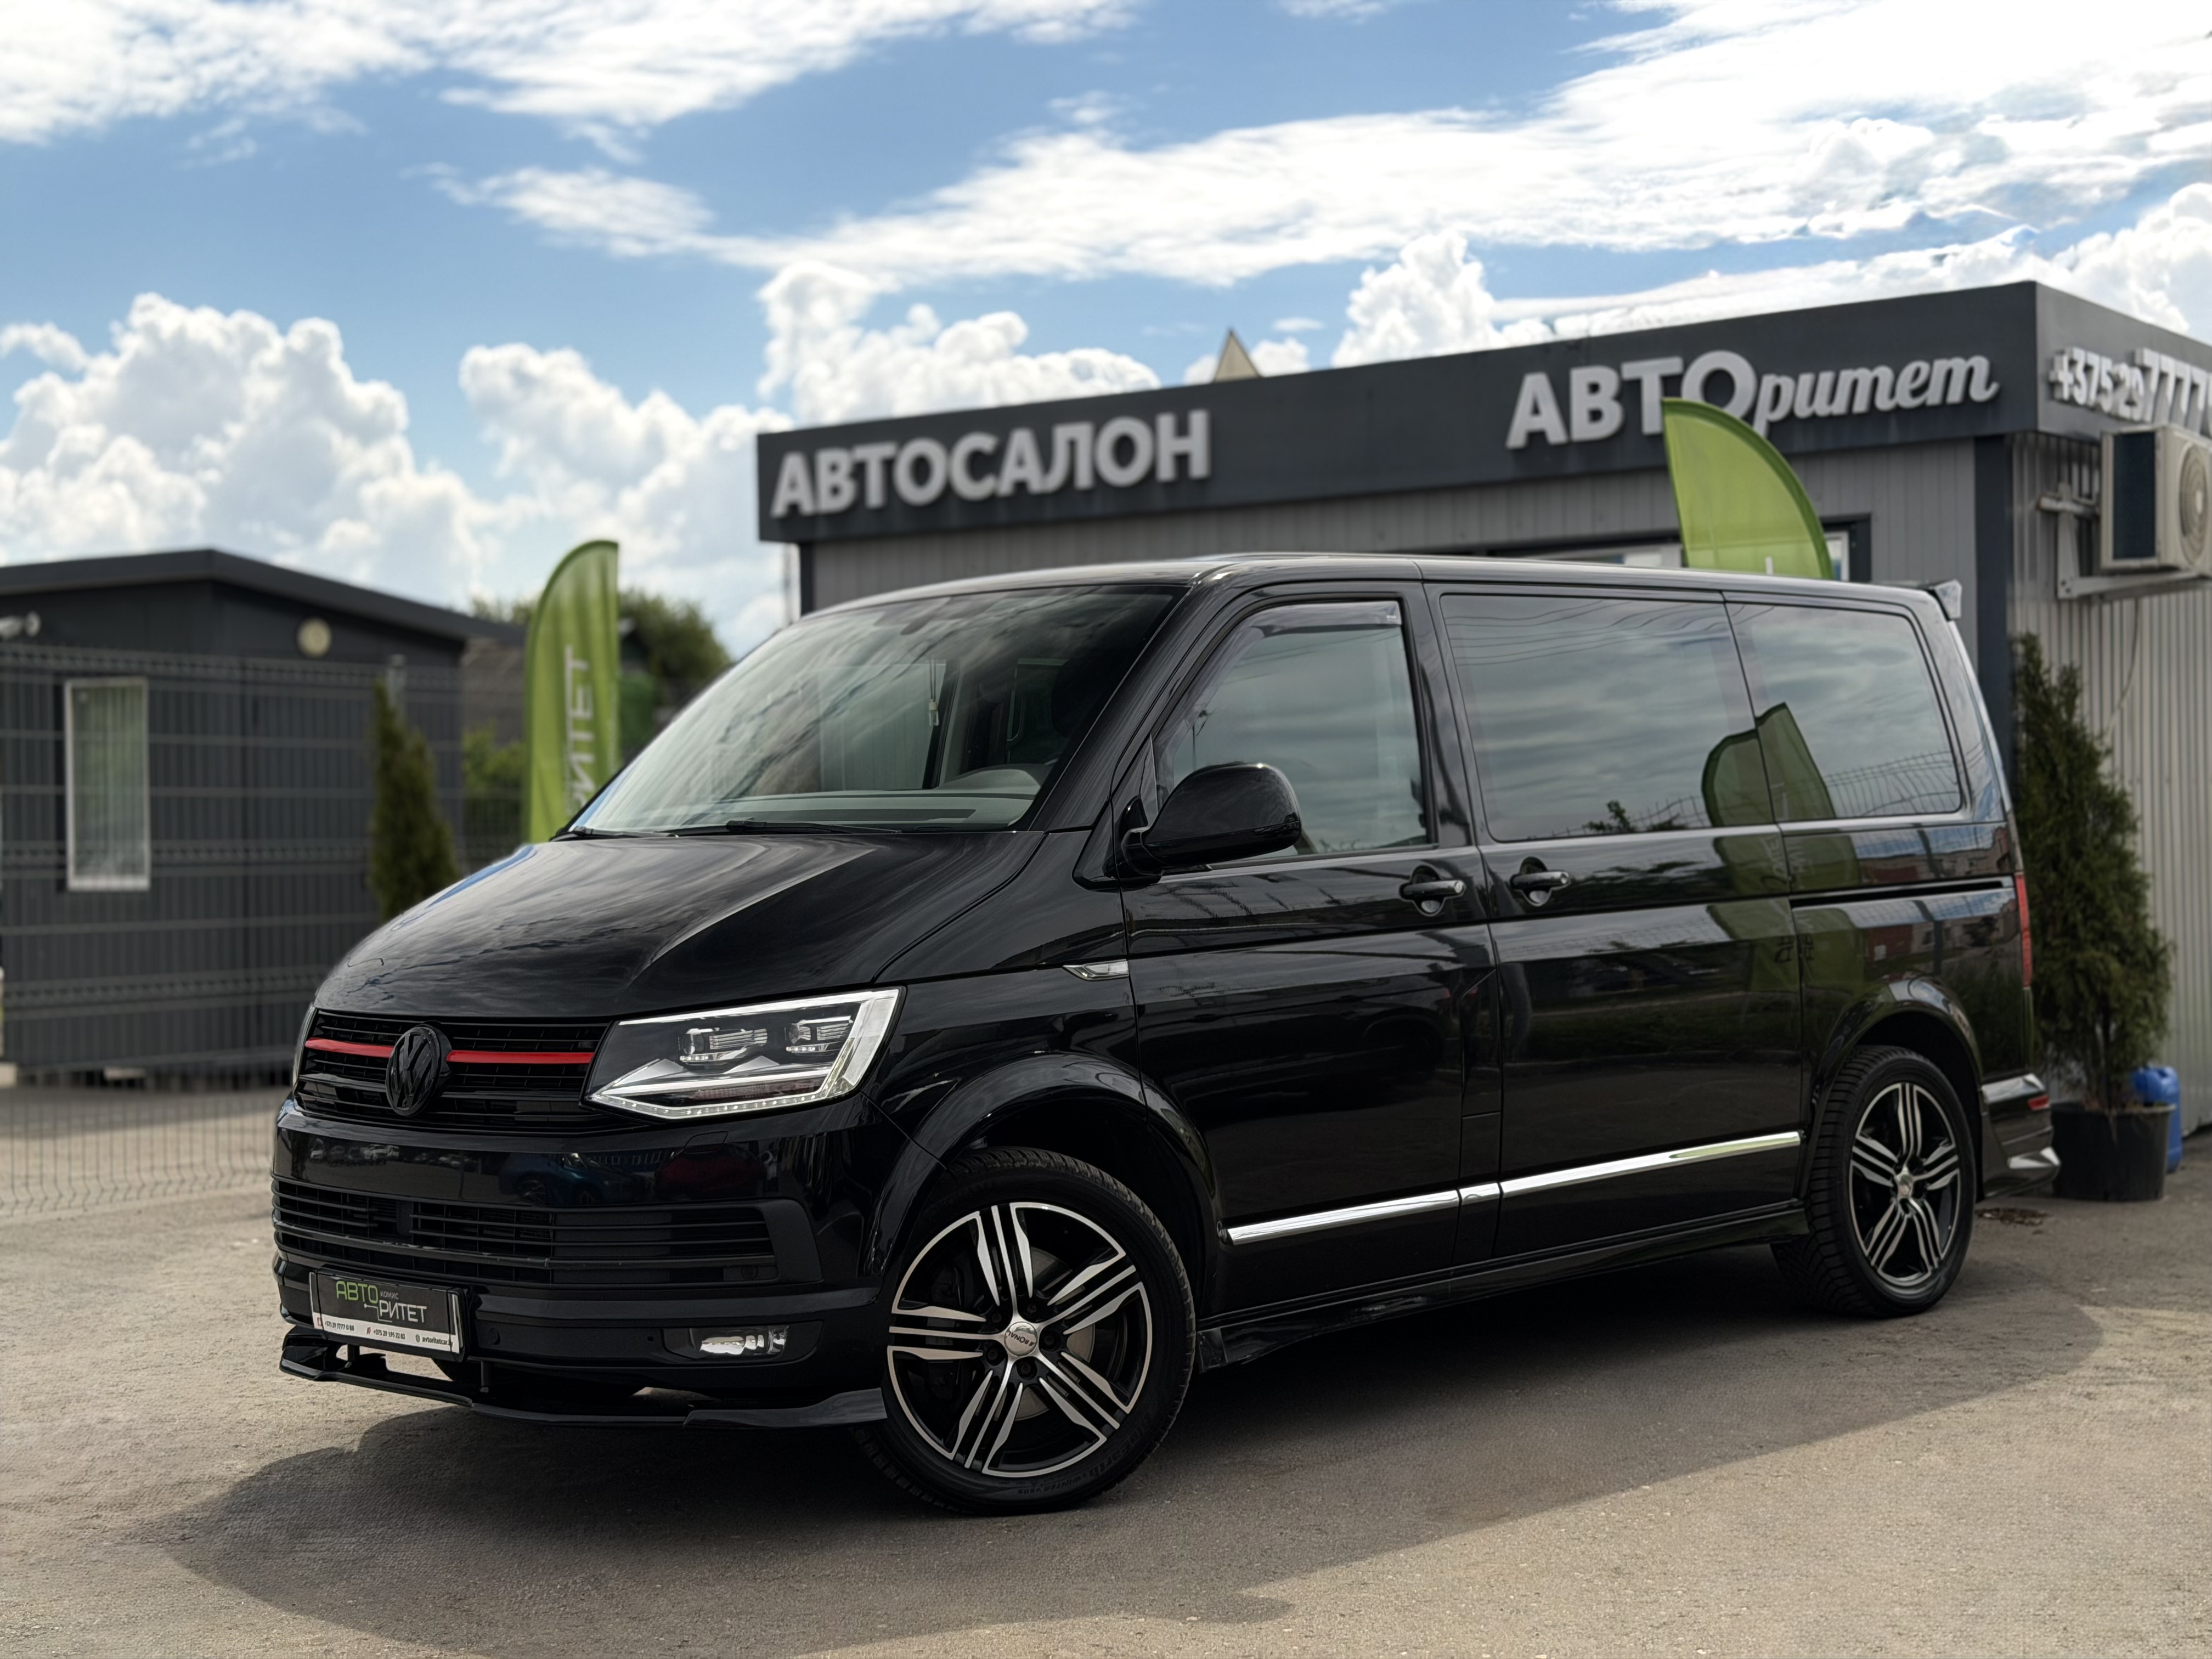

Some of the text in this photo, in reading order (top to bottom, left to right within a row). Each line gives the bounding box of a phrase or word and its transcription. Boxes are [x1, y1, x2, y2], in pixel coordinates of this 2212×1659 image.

[770, 410, 1210, 517] АВТОСАЛОН
[336, 1280, 379, 1304] АВТО
[380, 1290, 399, 1300] КОМИС
[379, 1299, 427, 1323] РИТЕТ
